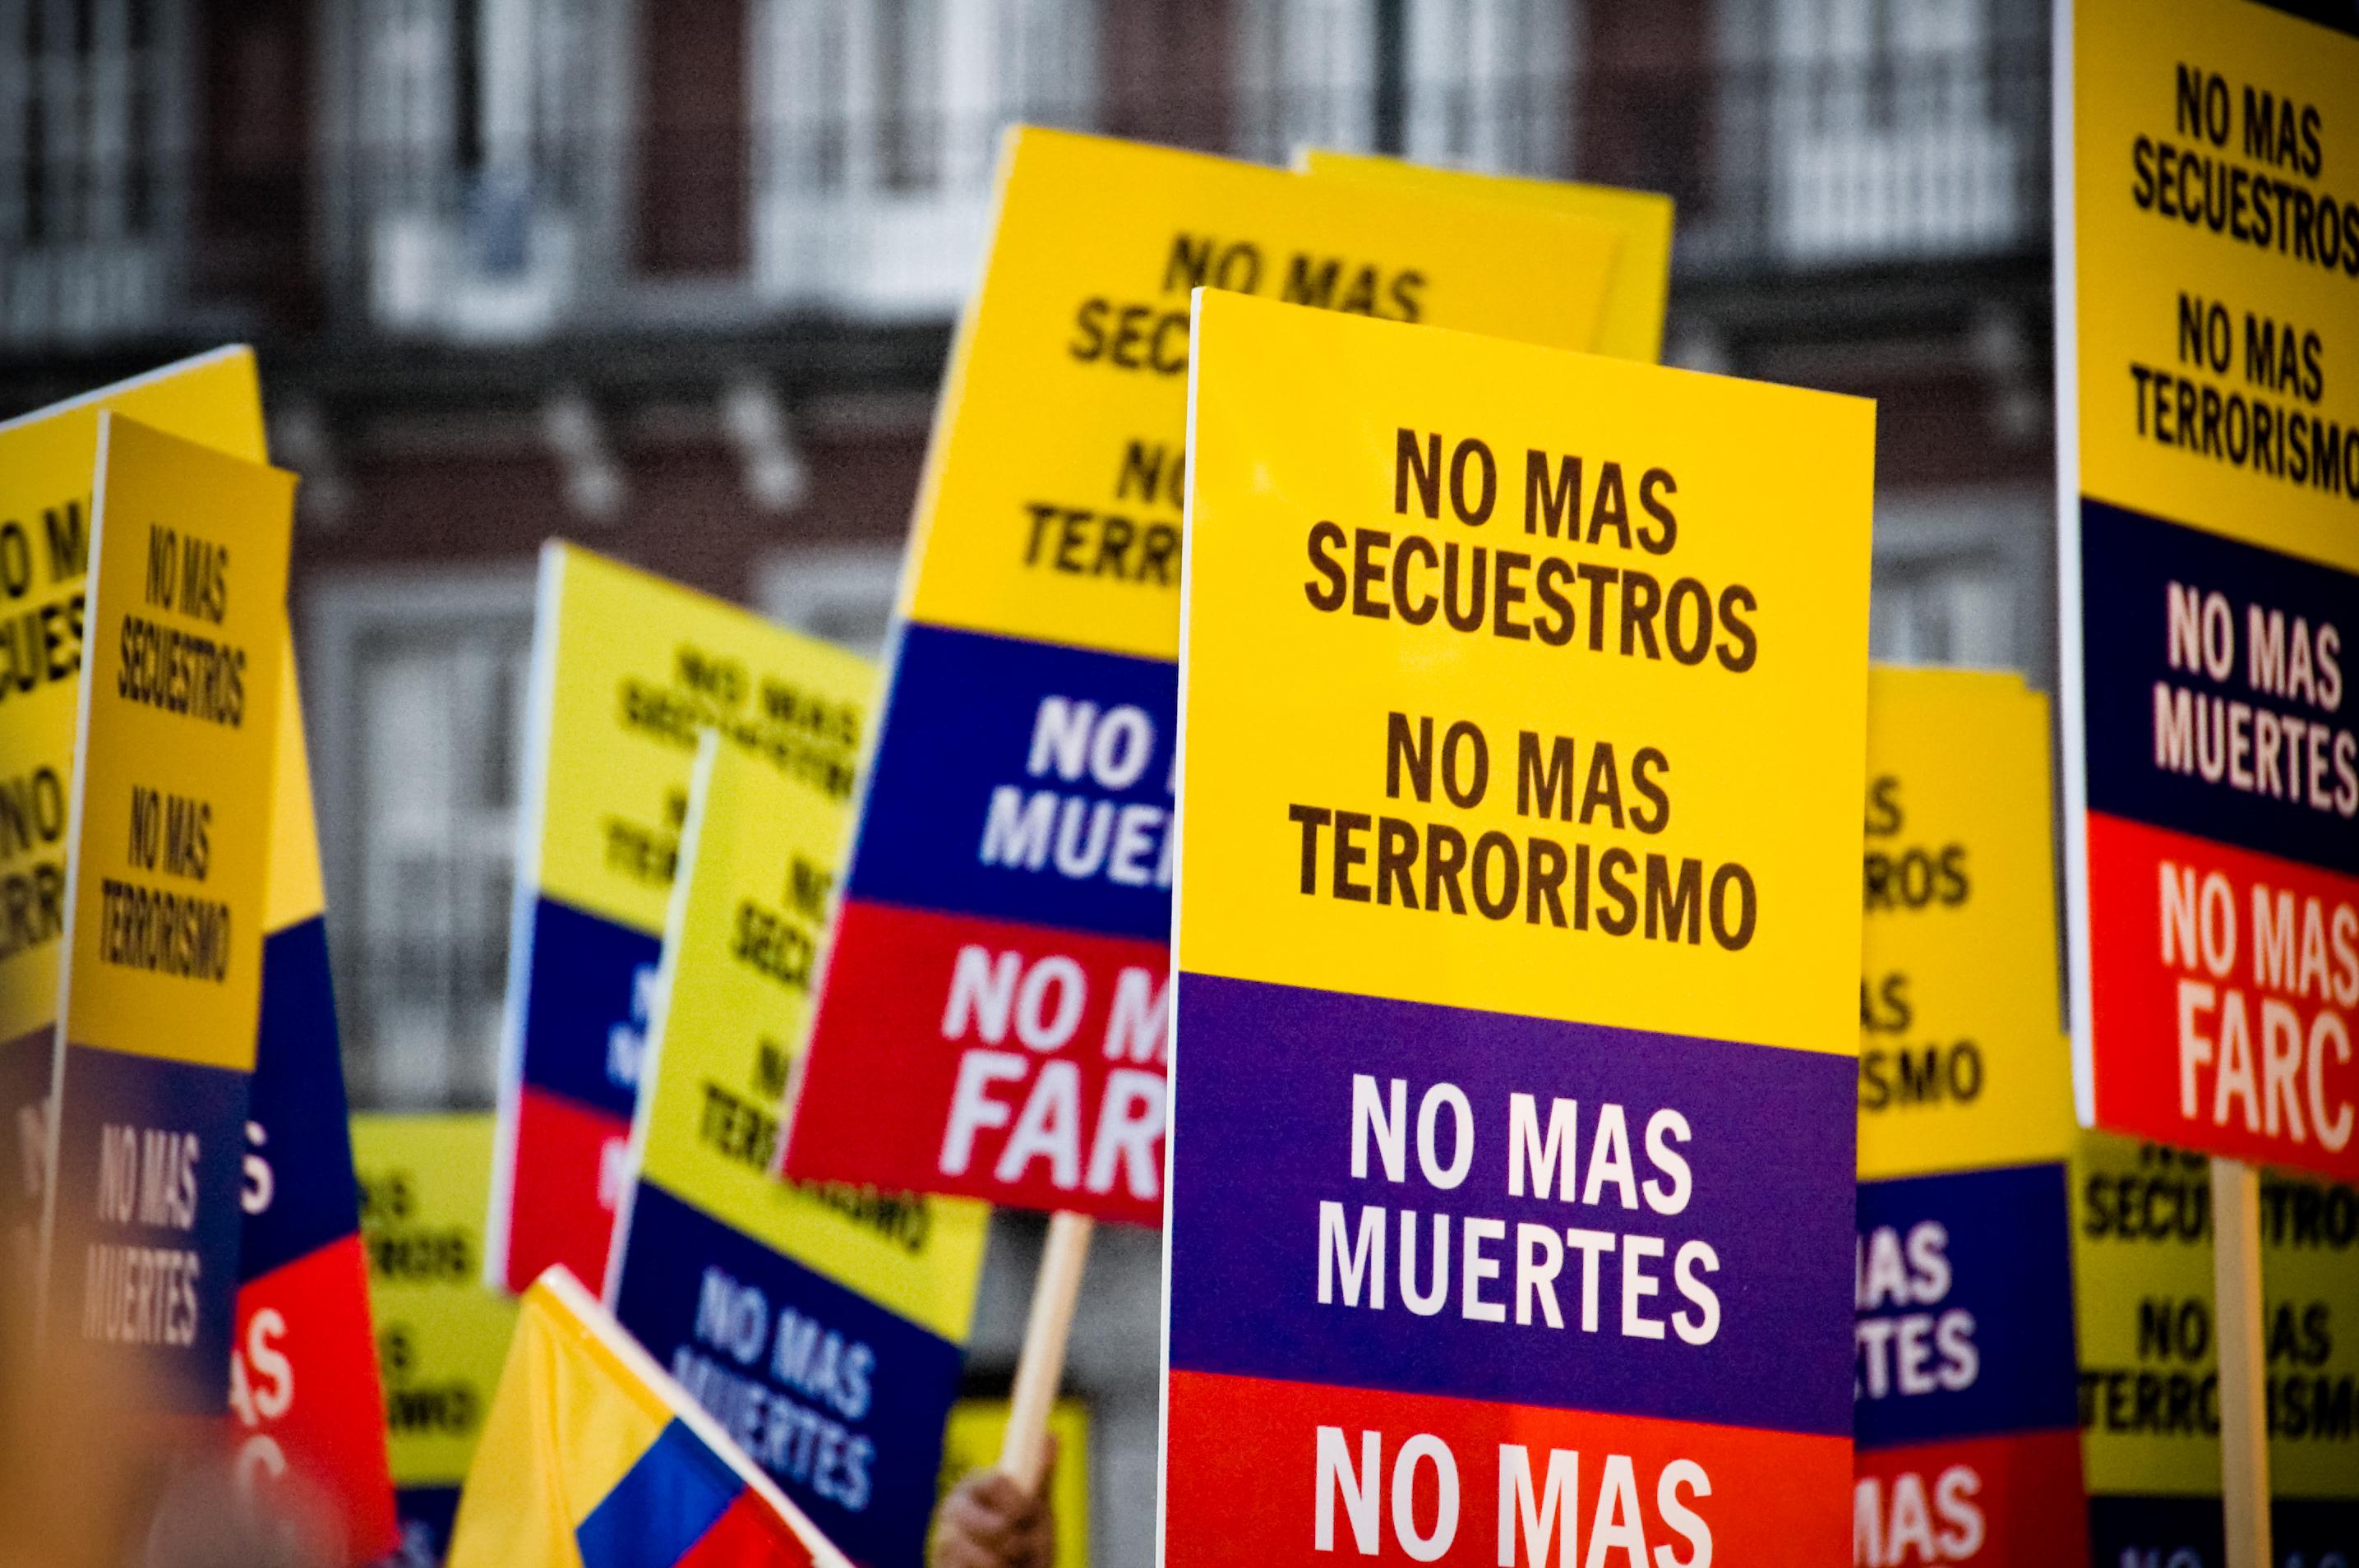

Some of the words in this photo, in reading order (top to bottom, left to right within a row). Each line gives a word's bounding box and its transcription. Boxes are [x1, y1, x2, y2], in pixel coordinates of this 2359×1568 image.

[2176, 62, 2232, 148] NO
[2243, 85, 2323, 180] MAS
[2131, 133, 2359, 278] SECUESTROS
[2177, 290, 2232, 376] NO
[2246, 311, 2324, 404] MAS
[1395, 427, 1497, 527] NO
[1524, 449, 1678, 556] MAS
[145, 521, 177, 611] NO
[178, 533, 229, 627] MAS
[1304, 520, 1758, 674] SECUESTROS
[118, 612, 246, 727] SECUESTROS
[2167, 580, 2234, 682] NO
[2247, 604, 2343, 711] MAS
[1026, 694, 1151, 791] NO
[1386, 711, 1489, 809] NO
[1516, 730, 1670, 834] MAS
[2154, 682, 2358, 819] MUERTES
[128, 784, 159, 870] NO
[164, 793, 212, 882] MAS
[1288, 803, 1757, 952] TERRORISMO
[99, 876, 232, 982] TERRORISMO
[2159, 861, 2237, 977] NO
[2252, 883, 2359, 1009] MAS
[939, 943, 1087, 1054] NO
[2177, 980, 2354, 1152] FARC
[98, 1123, 138, 1224] NO
[139, 1128, 200, 1229] MAS
[1350, 1073, 1475, 1189] NO
[1508, 1092, 1692, 1215] MAS
[1318, 1201, 1721, 1345] MUERTES
[2138, 1297, 2210, 1362] NO
[695, 1266, 769, 1366] NO
[771, 1305, 875, 1420] MAS
[1315, 1425, 1460, 1562] NO
[1498, 1443, 1712, 1568] MAS
